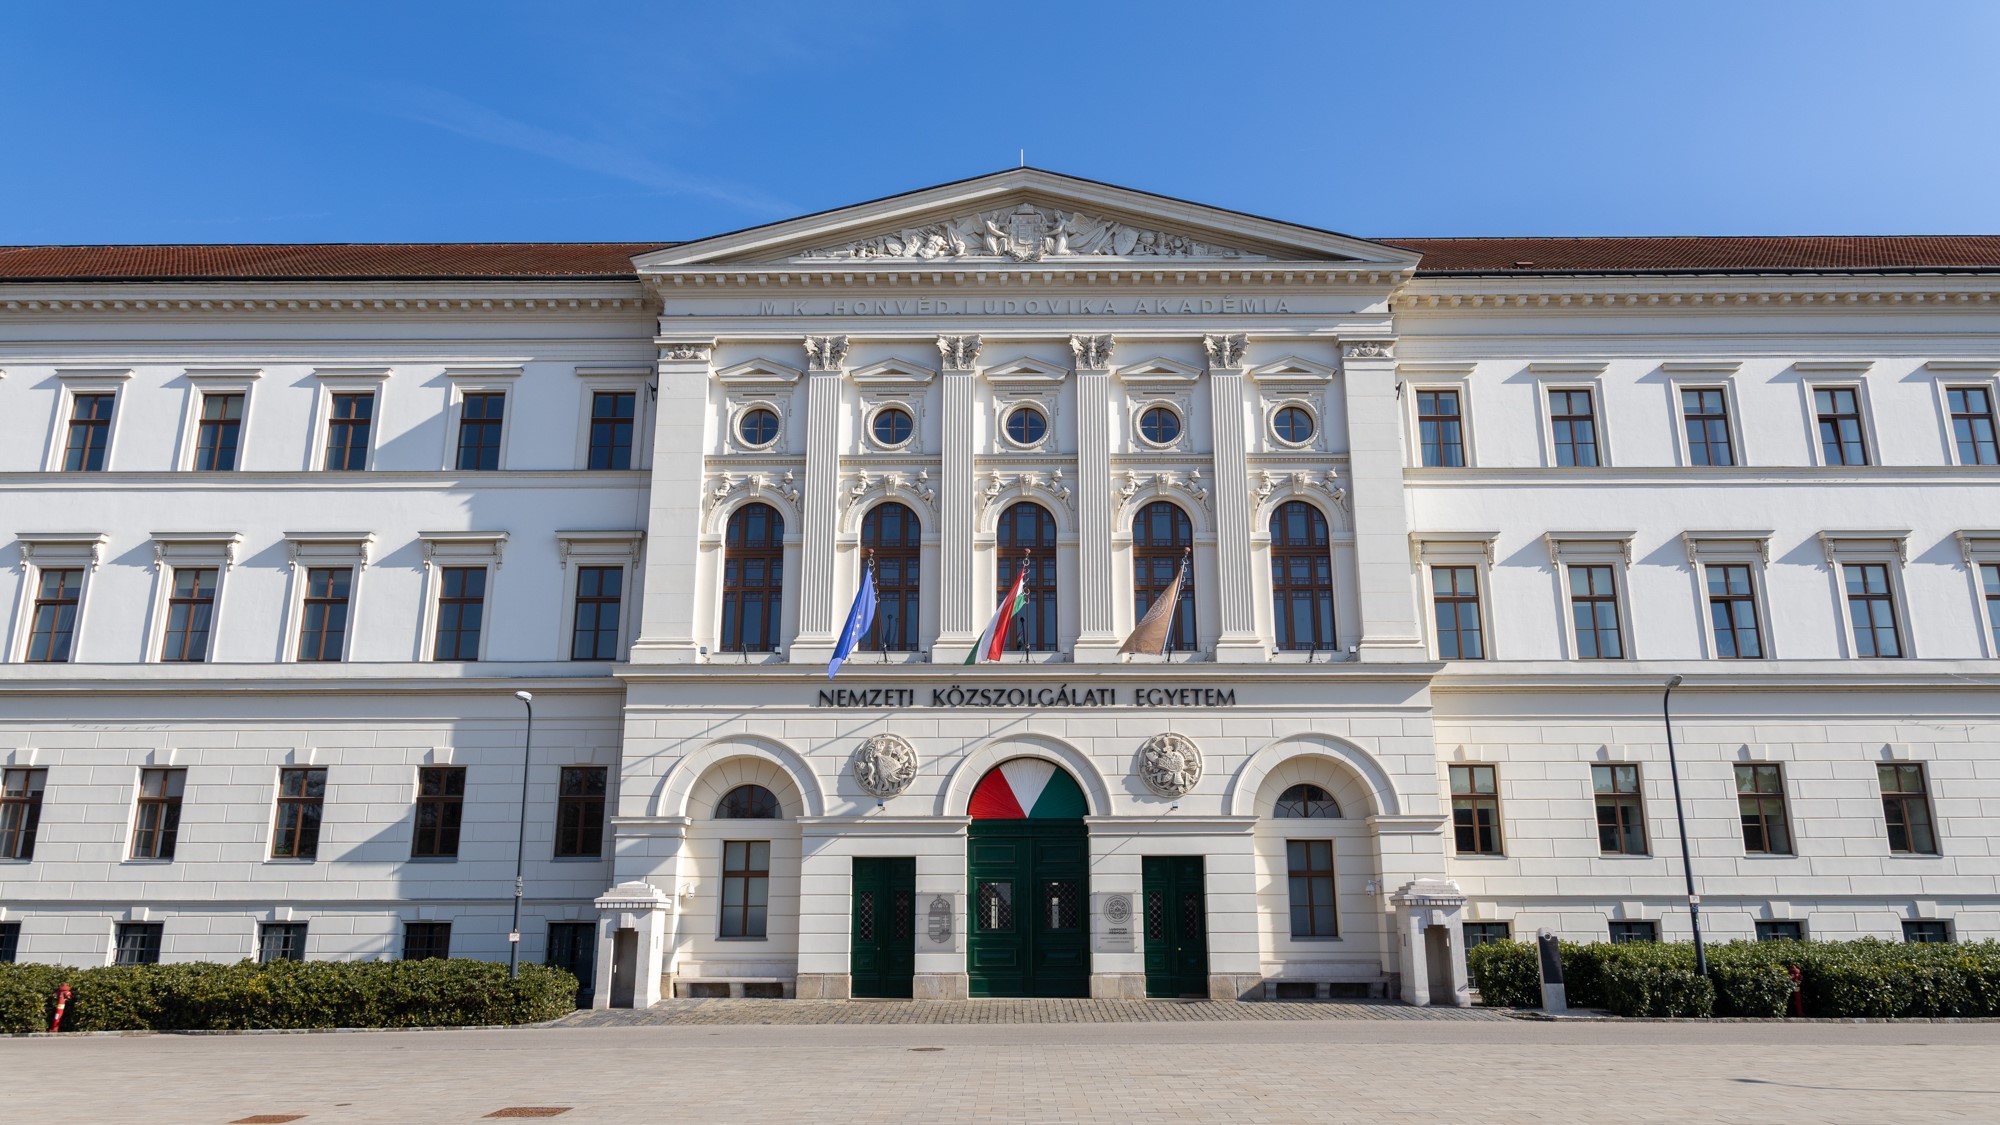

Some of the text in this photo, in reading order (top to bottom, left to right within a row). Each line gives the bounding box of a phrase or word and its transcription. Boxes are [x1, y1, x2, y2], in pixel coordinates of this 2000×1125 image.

[1134, 295, 1290, 315] AKADÉMIA
[819, 684, 1237, 707] NEMZETI KÖZSZOLGÁLATI EGYETEM
